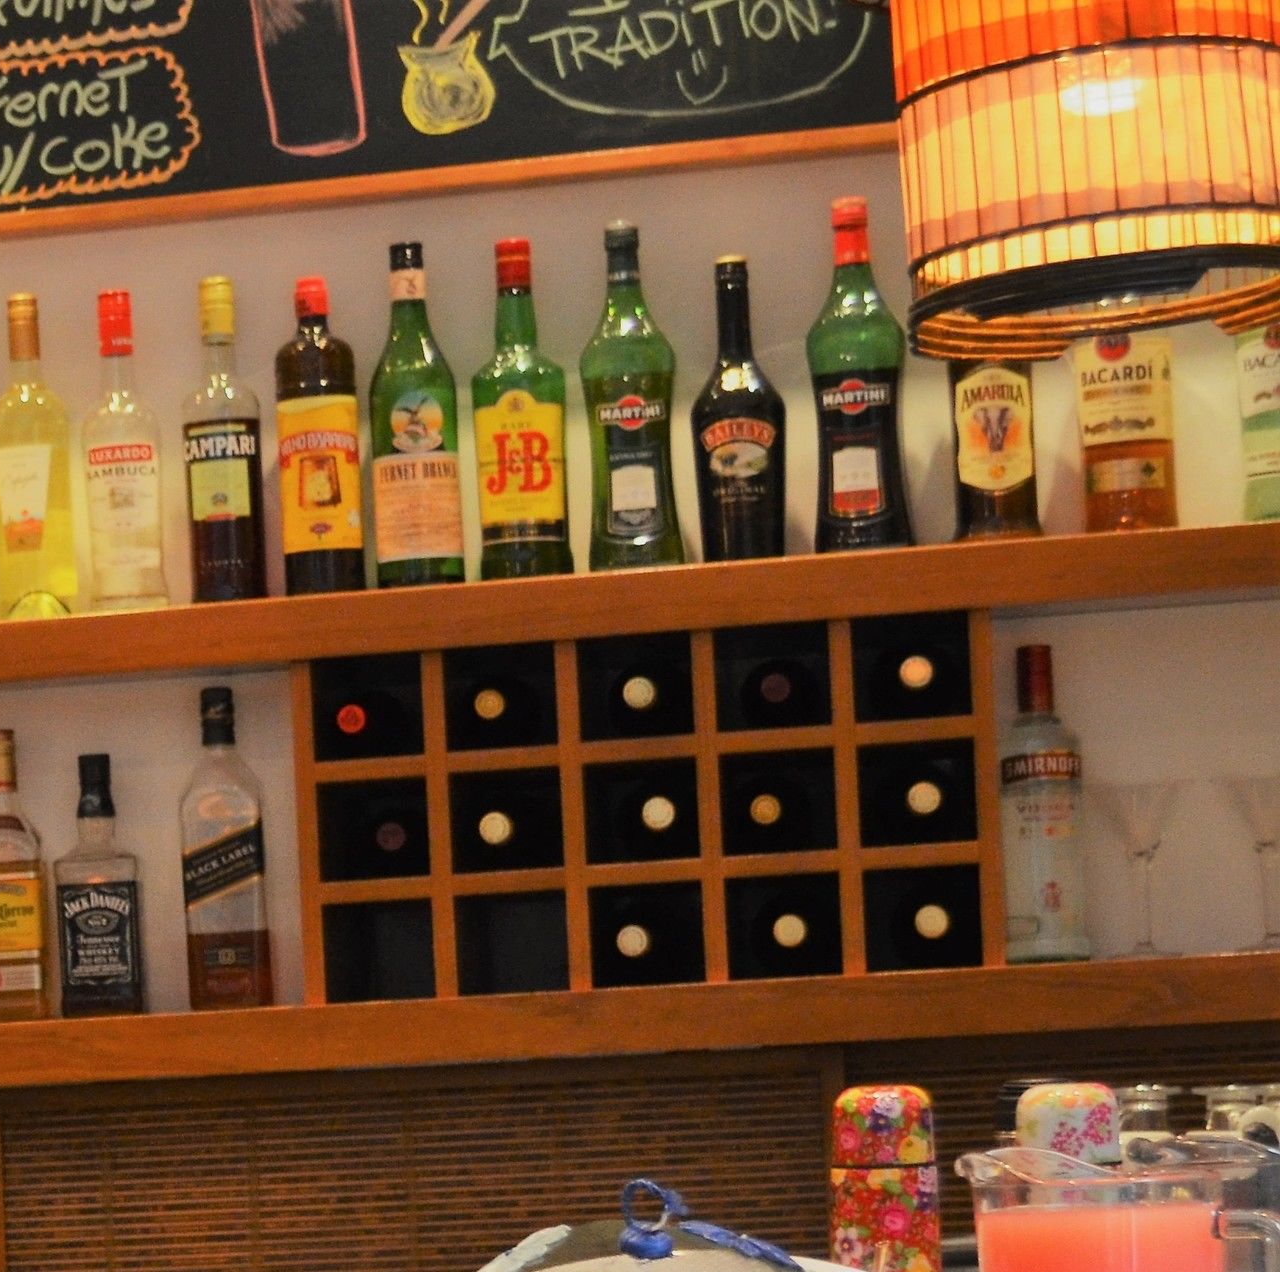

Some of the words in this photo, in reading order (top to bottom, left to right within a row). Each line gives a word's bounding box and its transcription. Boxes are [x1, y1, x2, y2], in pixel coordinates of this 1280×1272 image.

[823, 388, 888, 406] MARTINI
[599, 404, 661, 420] MARTINI
[185, 435, 256, 463] CAMPARI
[487, 431, 553, 495] J&B
[63, 897, 90, 919] JACK
